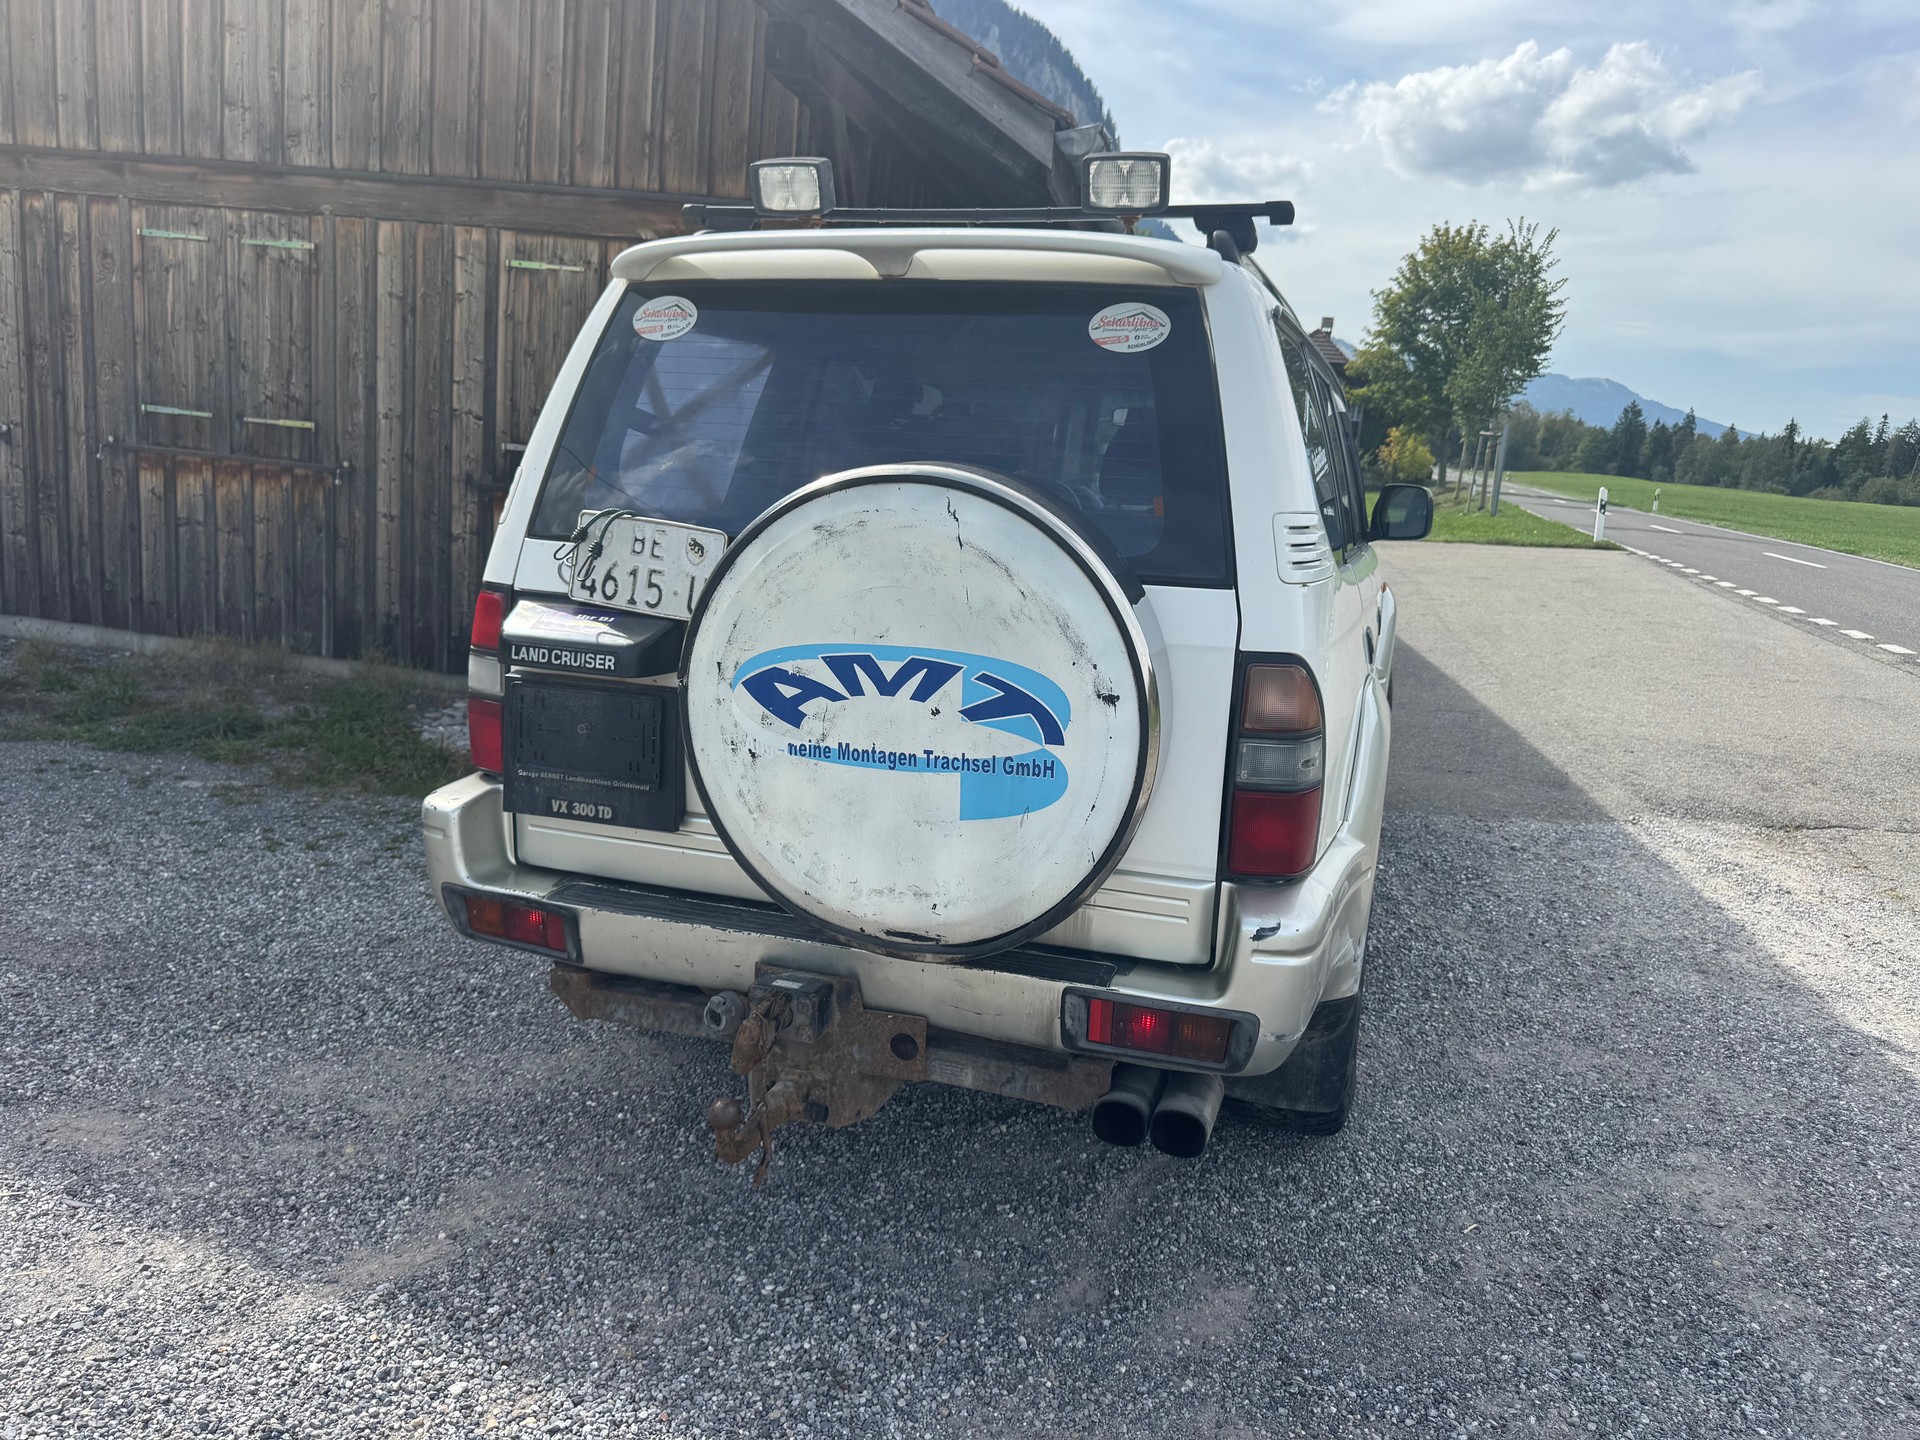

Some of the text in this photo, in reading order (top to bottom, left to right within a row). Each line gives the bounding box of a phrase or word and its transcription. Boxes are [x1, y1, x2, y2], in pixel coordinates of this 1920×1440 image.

[632, 523, 667, 560] BE
[580, 558, 663, 609] 4615
[511, 645, 616, 670] LAND CRUISER
[741, 654, 1065, 746] AMT
[837, 741, 918, 771] Montagen
[923, 750, 996, 774] Trachsel
[1002, 755, 1056, 779] GmbH
[517, 769, 539, 778] Garage
[540, 771, 565, 781] BERNET
[612, 780, 650, 791] Grindelwald
[551, 799, 613, 819] VX 300 TD
